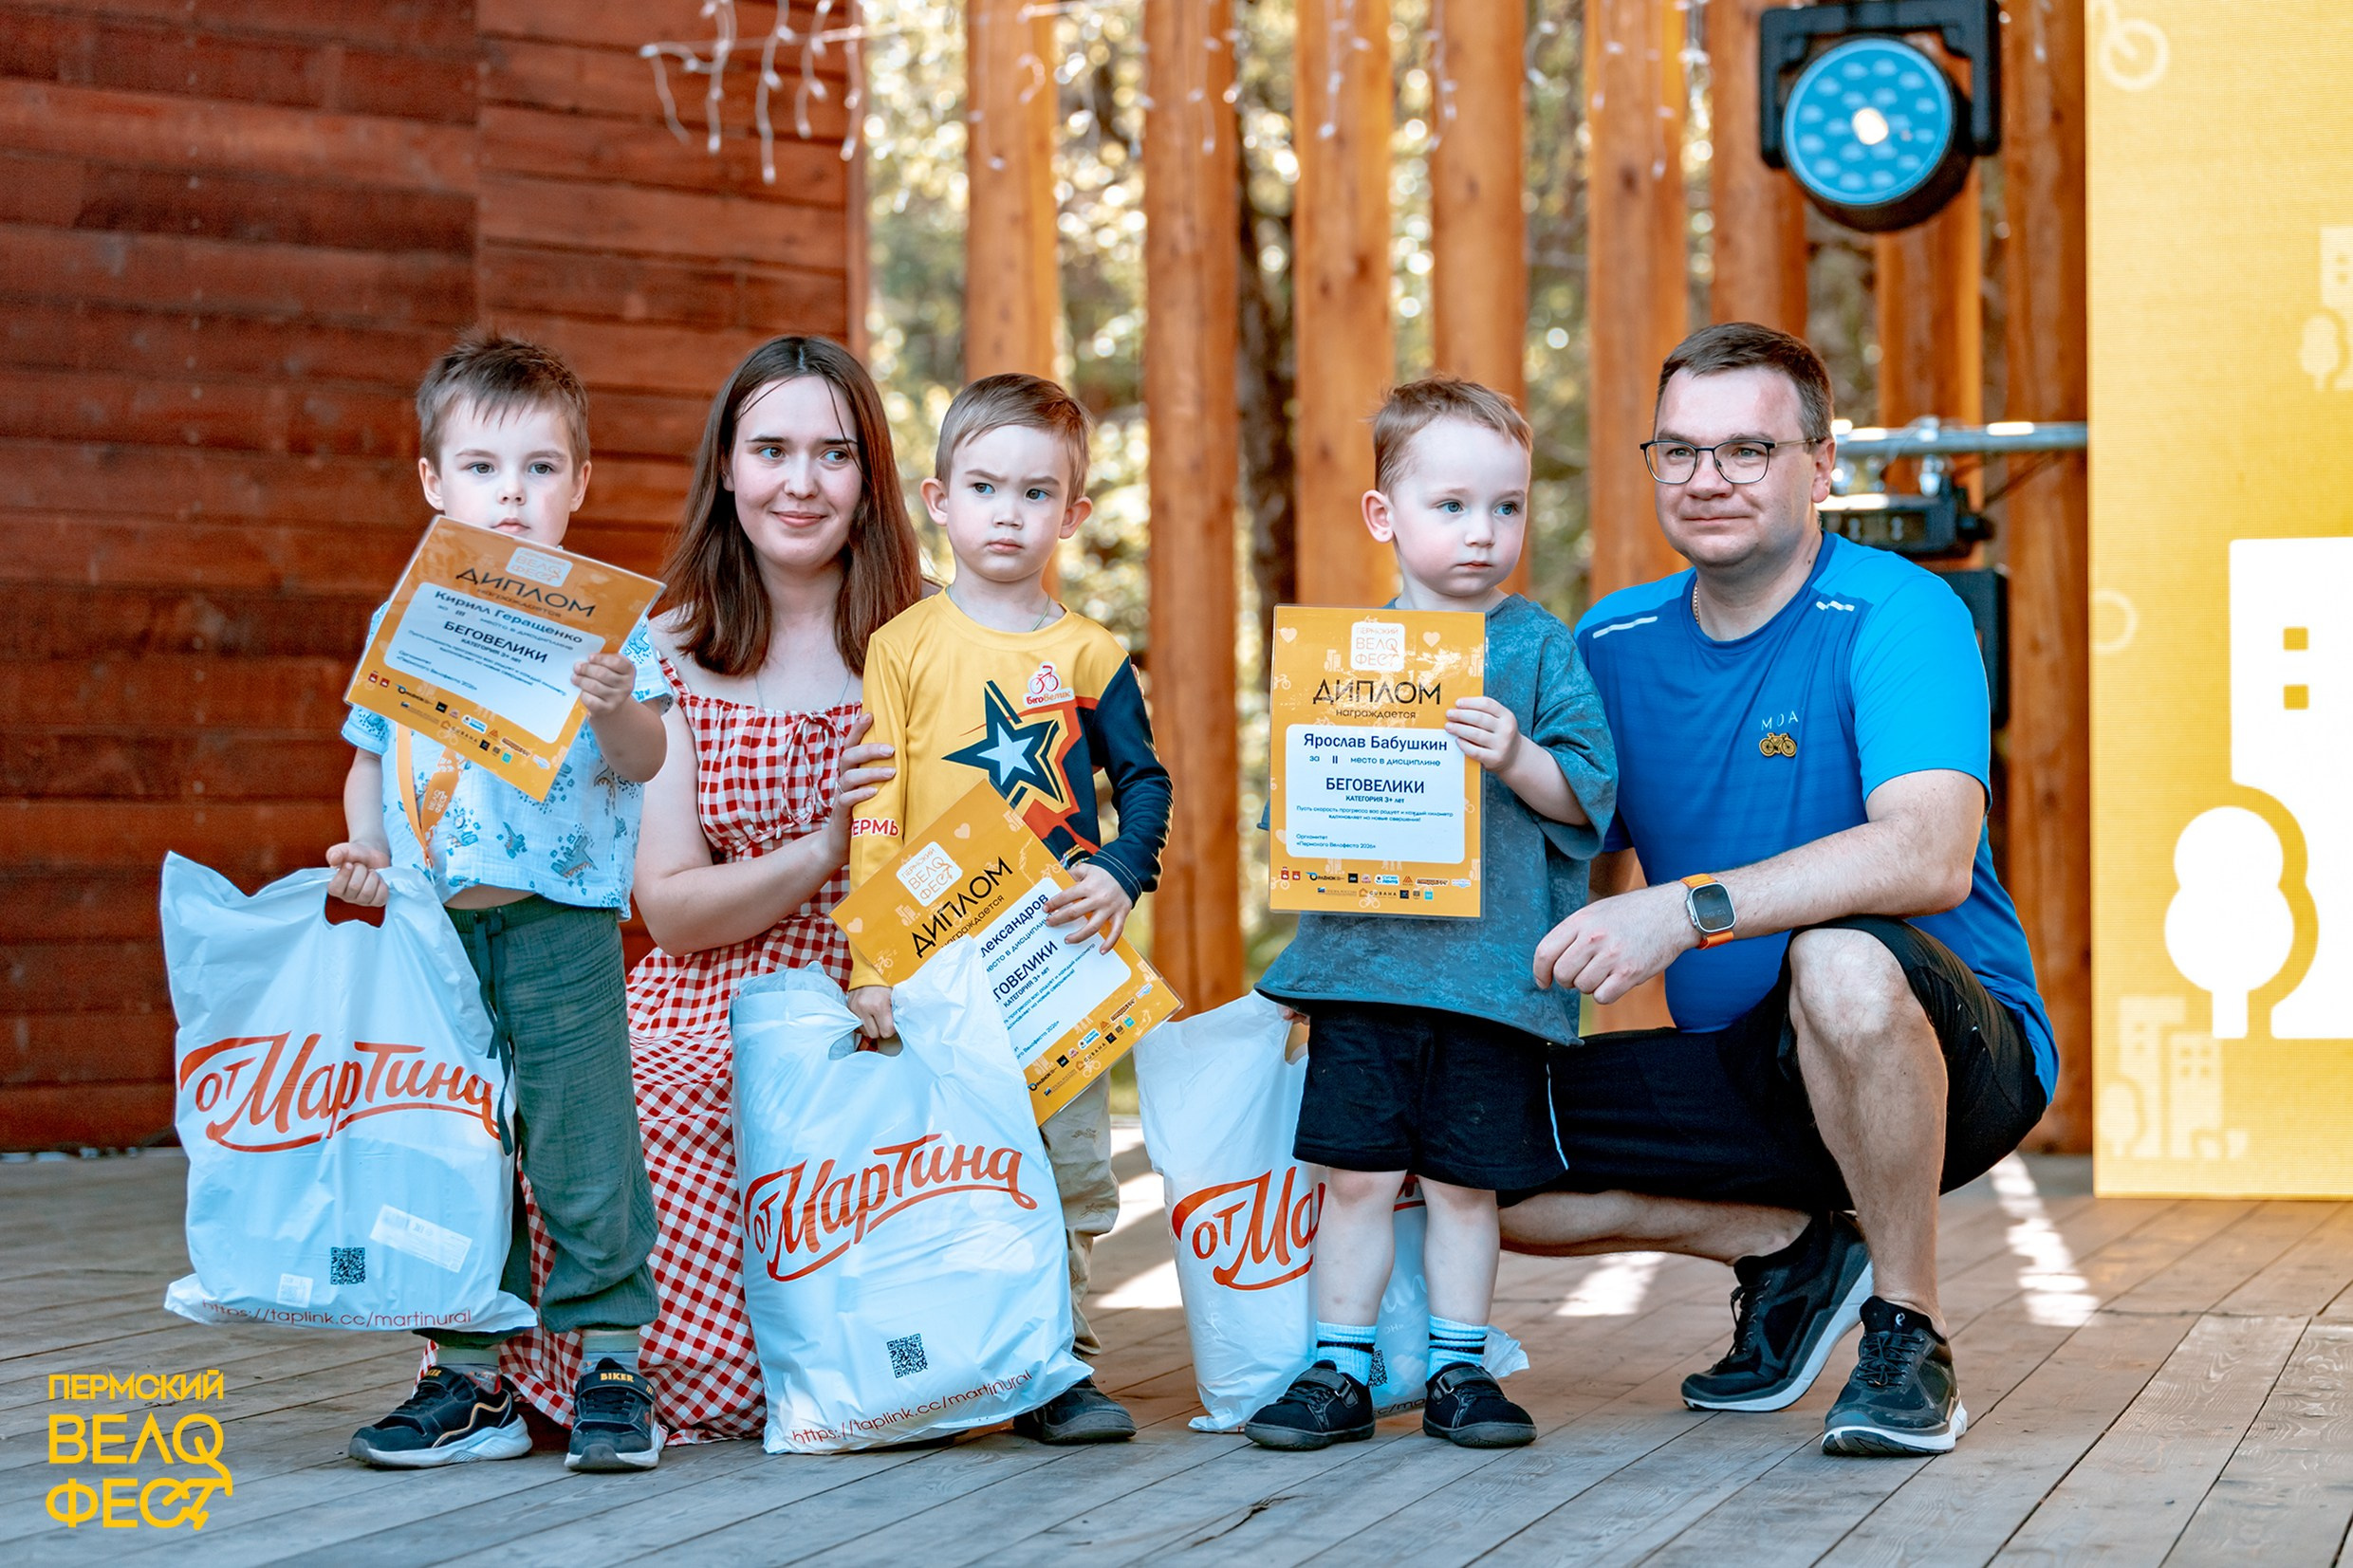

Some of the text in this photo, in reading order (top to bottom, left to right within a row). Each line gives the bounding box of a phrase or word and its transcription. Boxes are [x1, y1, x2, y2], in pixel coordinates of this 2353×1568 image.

[516, 556, 563, 575] ВЕЛО
[455, 567, 597, 618] ДИПЛОМ
[477, 589, 562, 618] награждается
[435, 591, 584, 643] Кирилл Геращенко
[444, 620, 548, 664] БЕГОВЕЛИКИ
[461, 638, 500, 655] КАТЕГОРИЯ
[480, 618, 509, 631] место
[518, 629, 574, 651] дисциплине
[1356, 637, 1399, 653] ВЕЛО
[1355, 654, 1399, 667] ФЕСТ
[1313, 679, 1441, 705] ДИПЛОМ
[1336, 709, 1417, 719] награждается
[1304, 733, 1447, 752] Ярослав Бабушкин
[1332, 755, 1338, 764] II
[1325, 777, 1424, 793] БЕГОВЕЛИКИ
[853, 819, 899, 836] ЕРМЬ
[908, 857, 945, 890] ВЕЛО
[919, 863, 954, 900] ФЕСТ
[911, 857, 1013, 959] ДИПЛОМ
[980, 894, 1048, 958] лександров
[993, 940, 1058, 1003] ГОВЕЛИКИ
[1003, 967, 1050, 1007] КАТЕГОРИЯ 3+ лет
[201, 1299, 472, 1328] https://taplink.cc/martinural
[601, 1373, 634, 1383] BIKER
[792, 1369, 1034, 1444] https://taplink.cc/martinural
